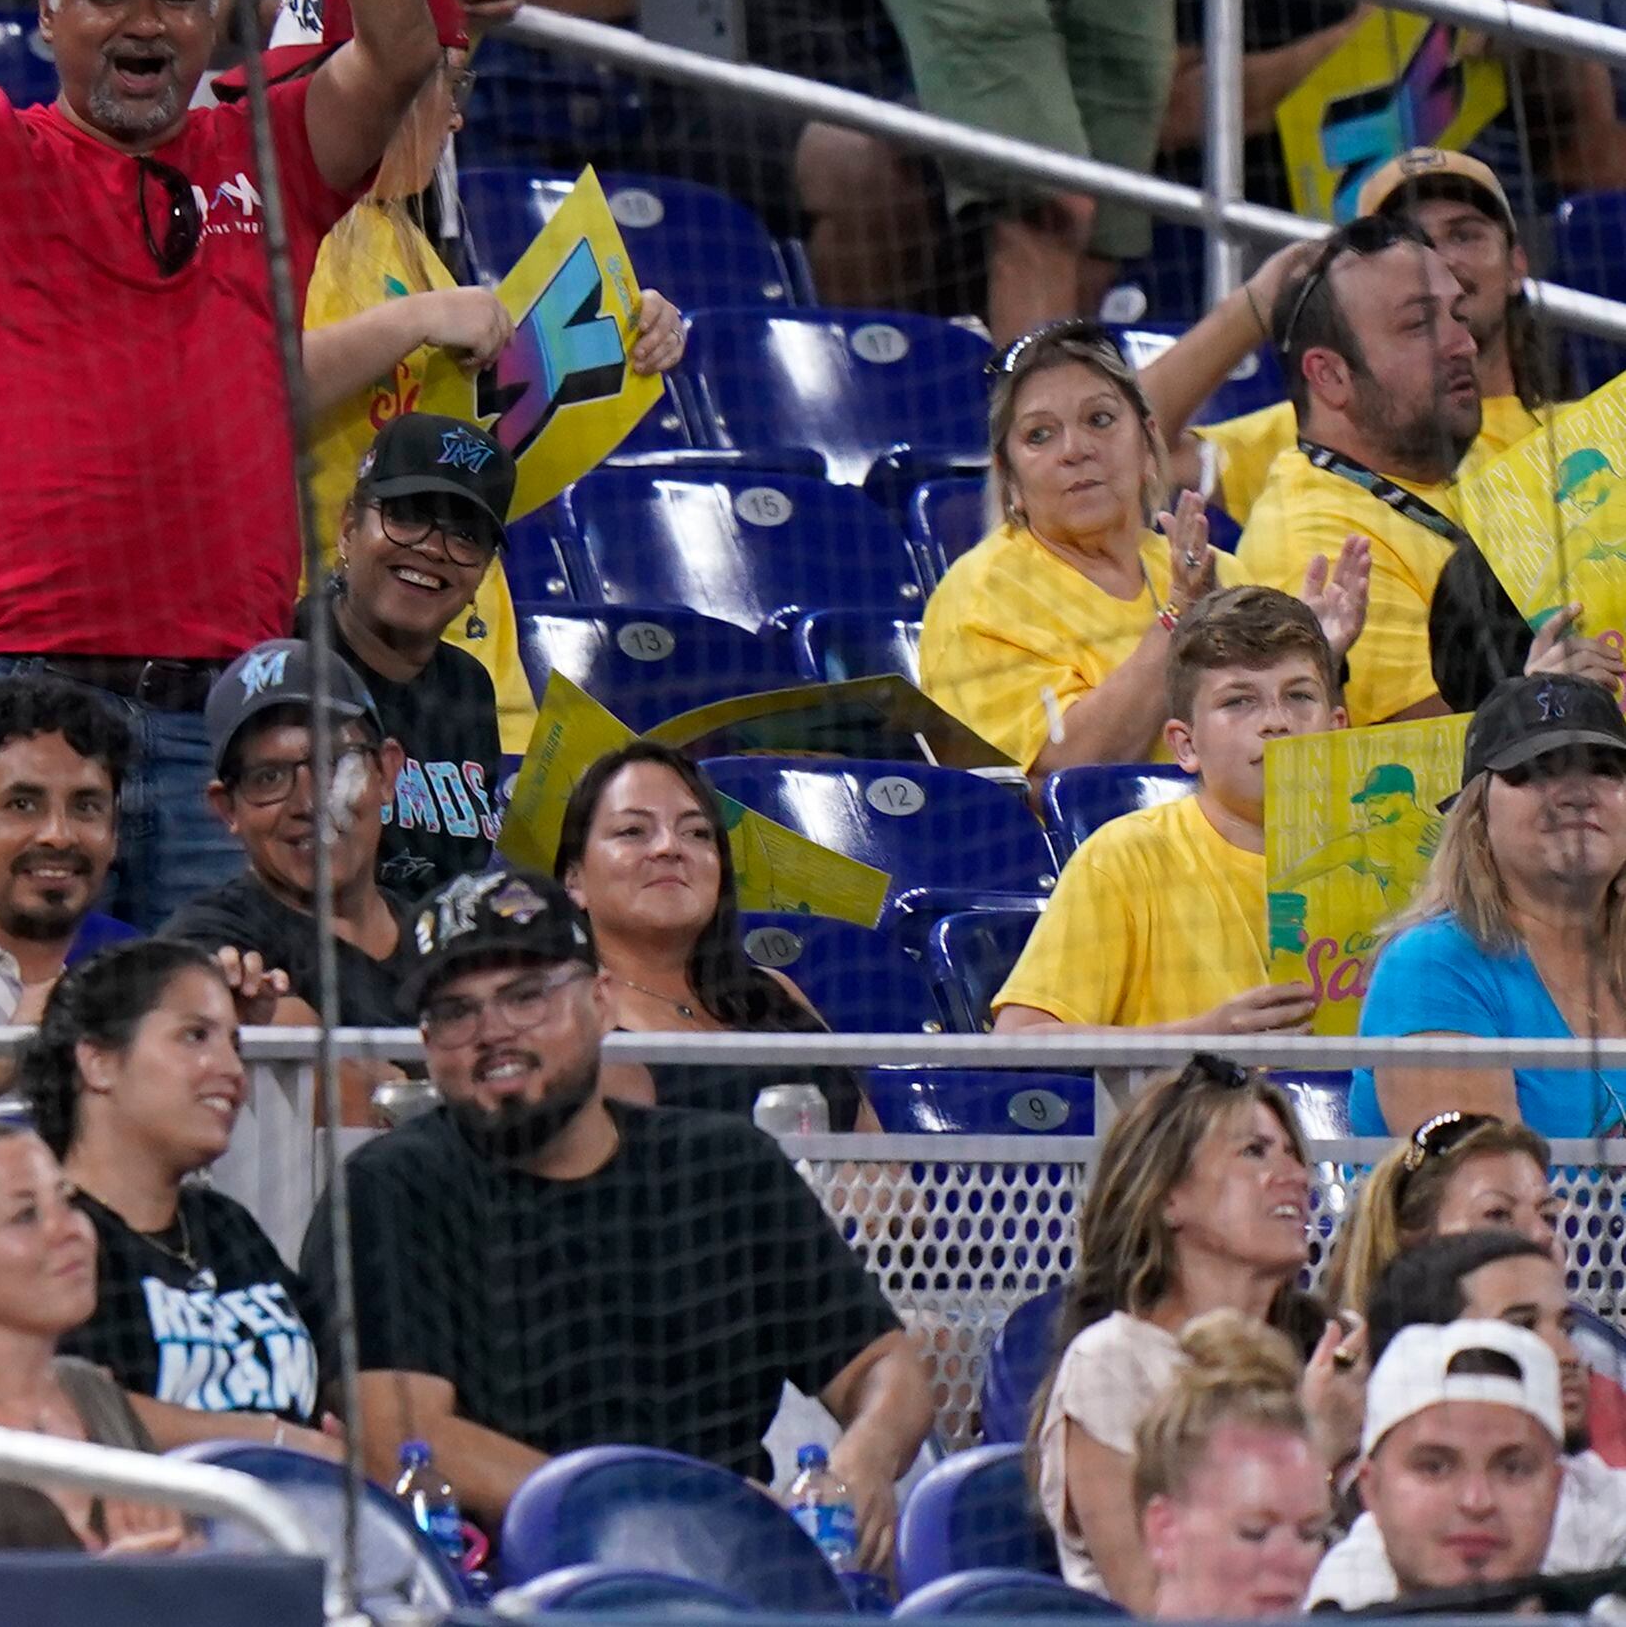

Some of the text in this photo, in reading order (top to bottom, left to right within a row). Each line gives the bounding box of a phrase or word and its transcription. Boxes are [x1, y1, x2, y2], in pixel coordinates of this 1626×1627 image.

[749, 493, 781, 519] 15
[629, 628, 662, 654] 13
[880, 783, 910, 808] 12
[757, 934, 789, 960] 10
[1028, 1096, 1048, 1122] 9
